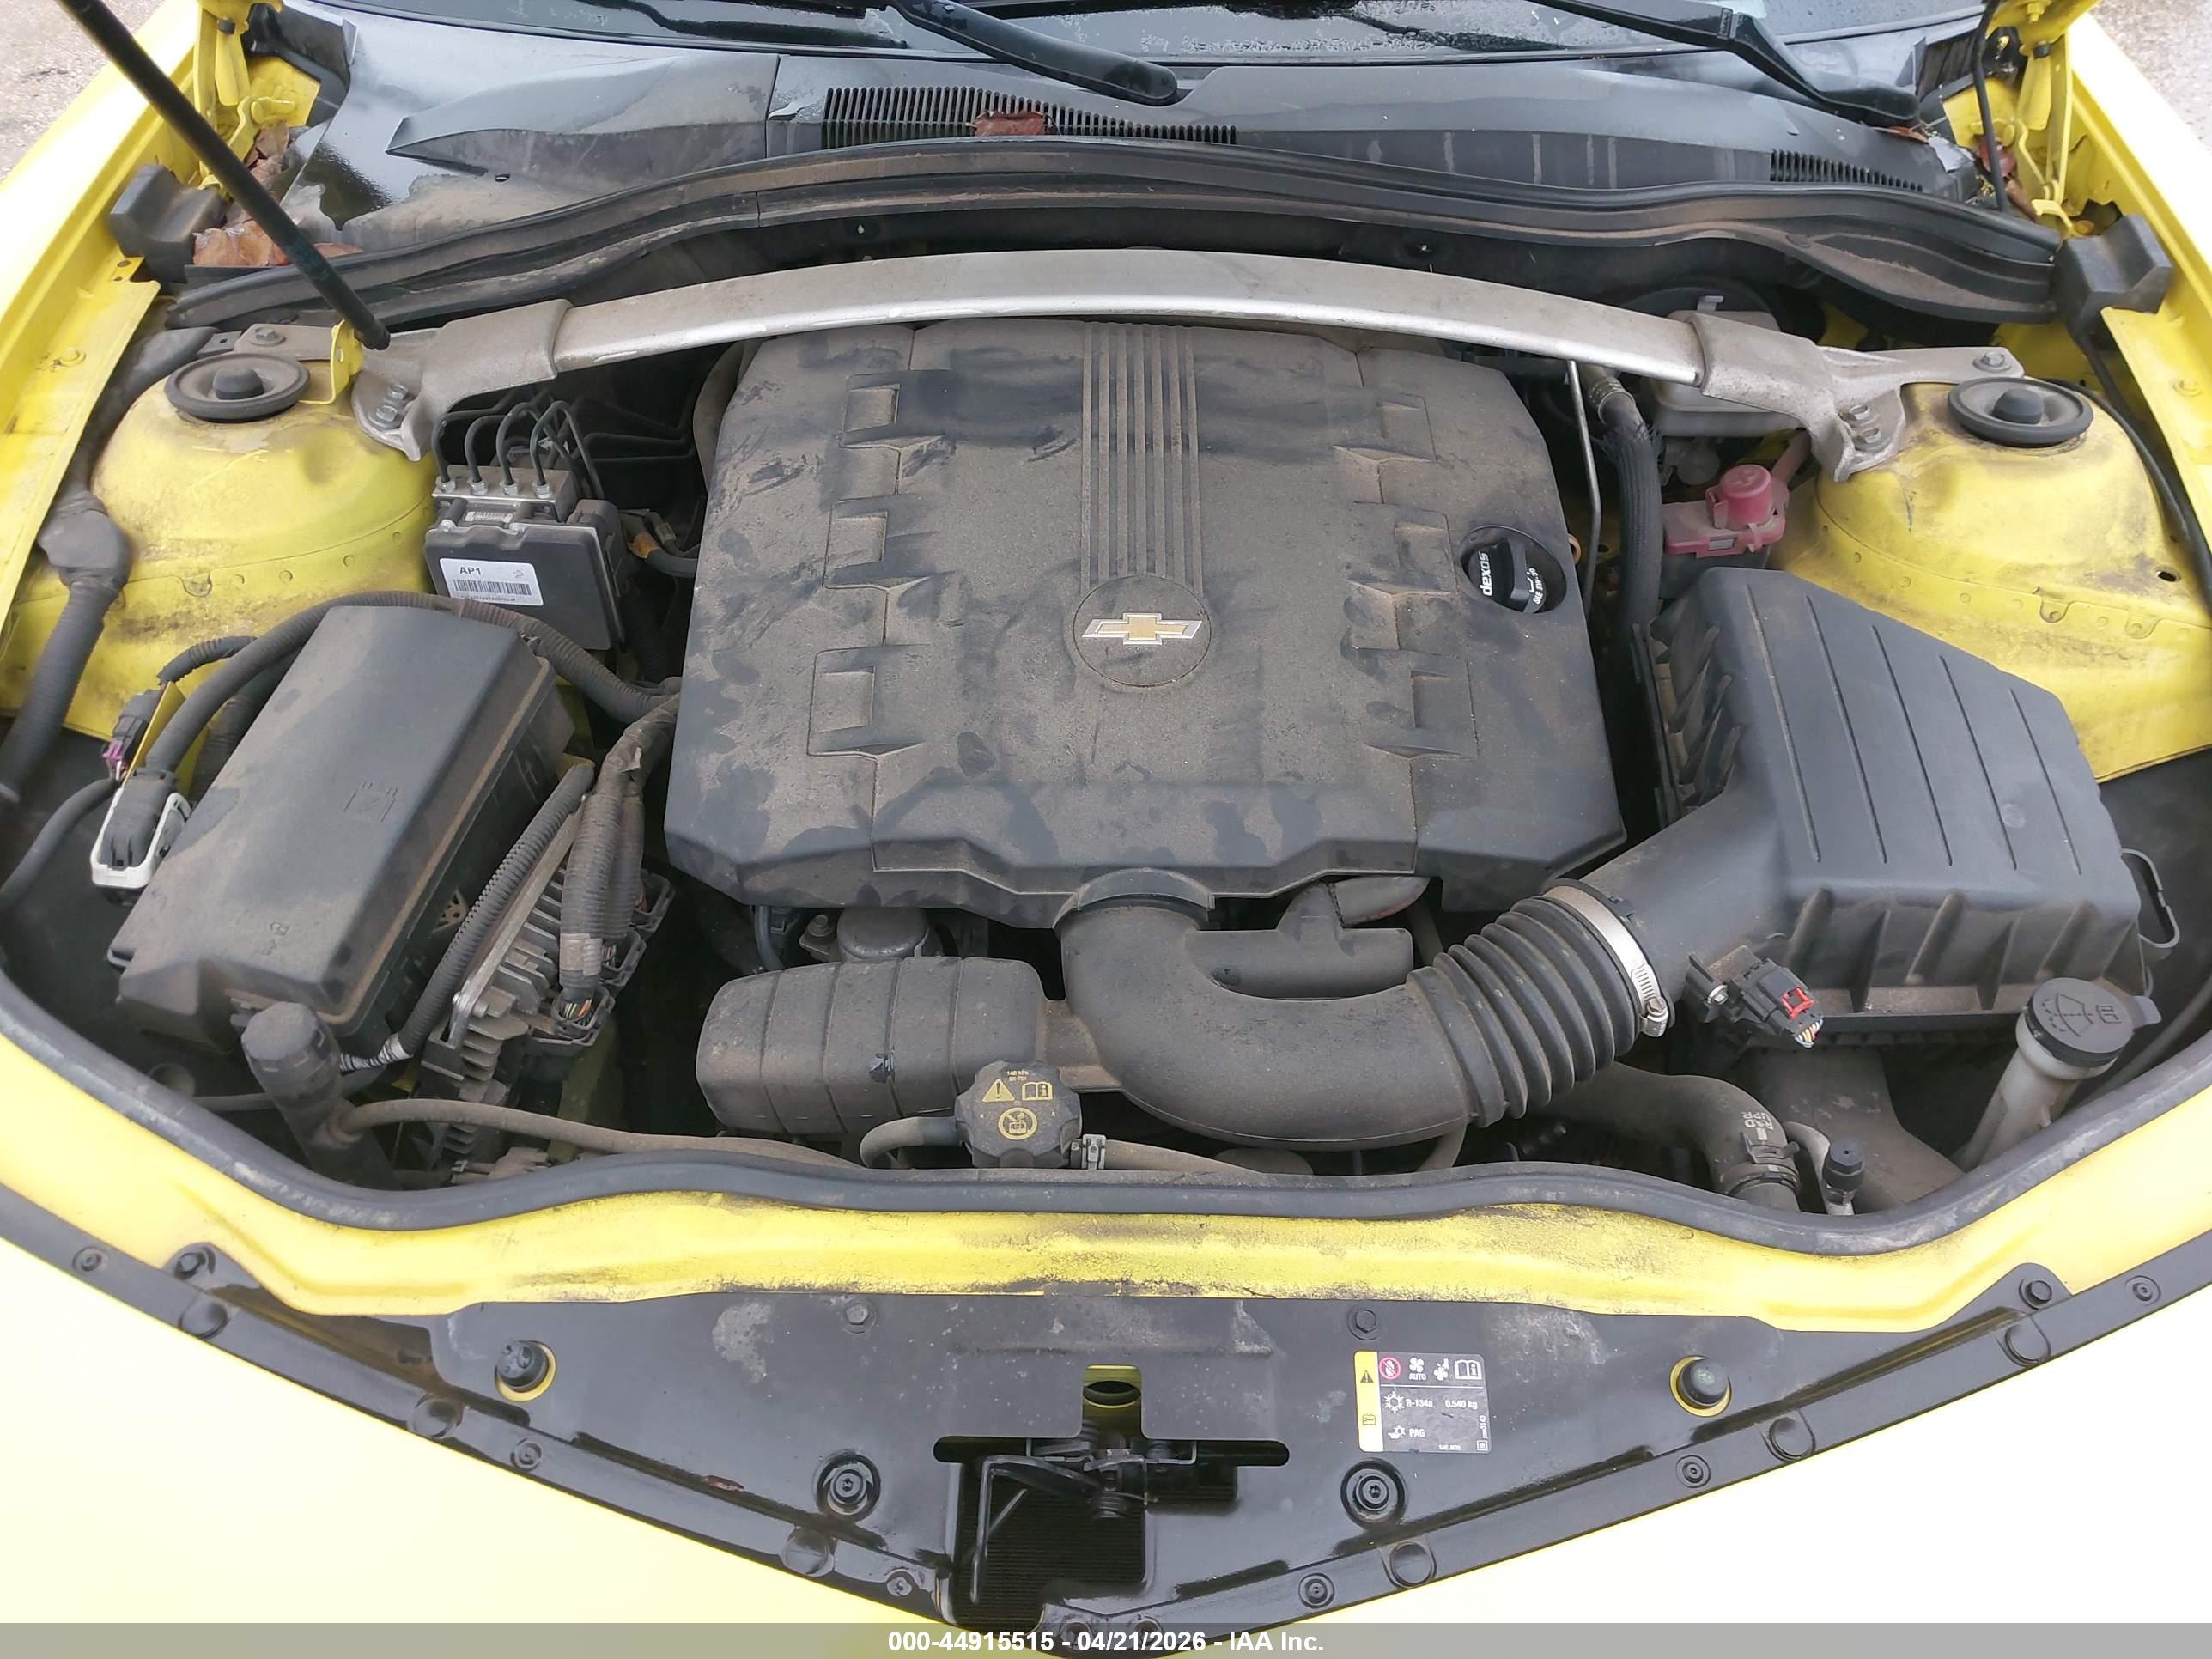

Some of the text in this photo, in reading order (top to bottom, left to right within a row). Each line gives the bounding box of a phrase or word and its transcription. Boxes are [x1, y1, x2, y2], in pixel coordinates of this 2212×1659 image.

[459, 566, 482, 576] AP1
[1478, 551, 1493, 597] dexos
[1406, 1398, 1478, 1410] R-134a 0.540 kg
[1408, 1429, 1426, 1437] PAG
